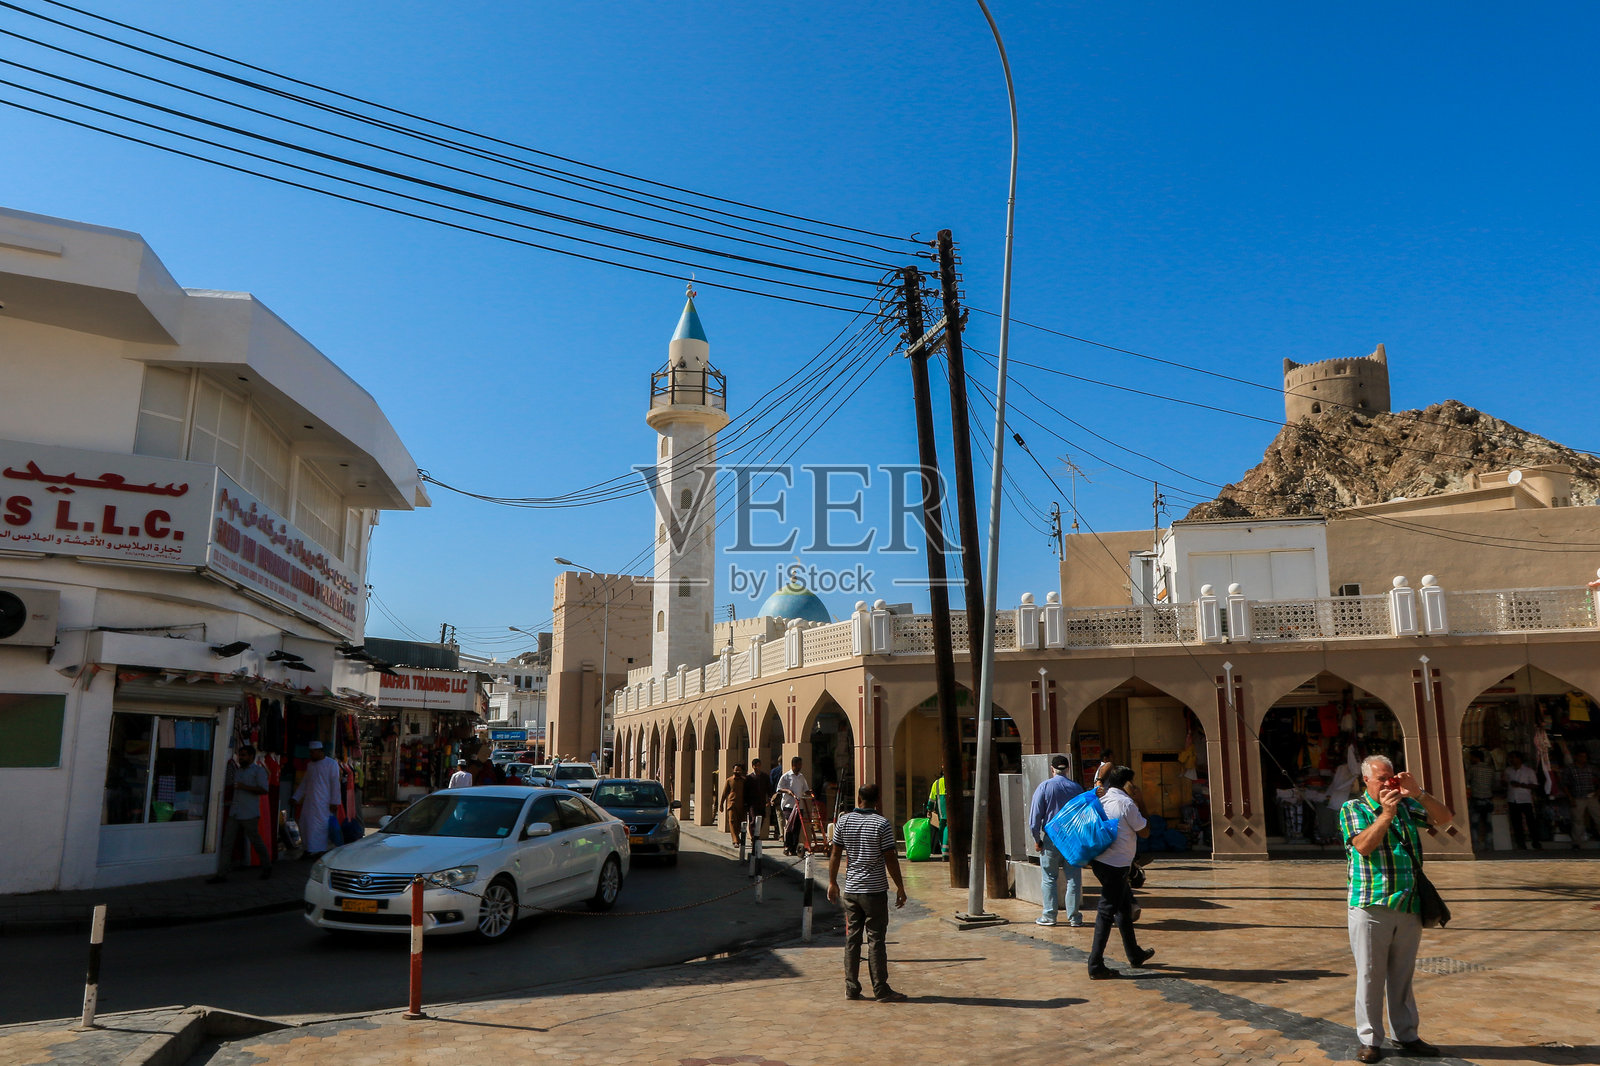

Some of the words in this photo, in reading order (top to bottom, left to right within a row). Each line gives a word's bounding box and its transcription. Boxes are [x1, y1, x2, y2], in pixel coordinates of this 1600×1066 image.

[3, 460, 189, 497] سعيد
[0, 496, 32, 526] S
[56, 500, 185, 541] L.L.C.
[12, 532, 54, 543] الملابس
[64, 534, 105, 546] الأقمشة
[114, 540, 152, 551] الملابس
[154, 544, 182, 555] تجارة
[412, 675, 451, 693] TRADING
[451, 679, 468, 693] LLC
